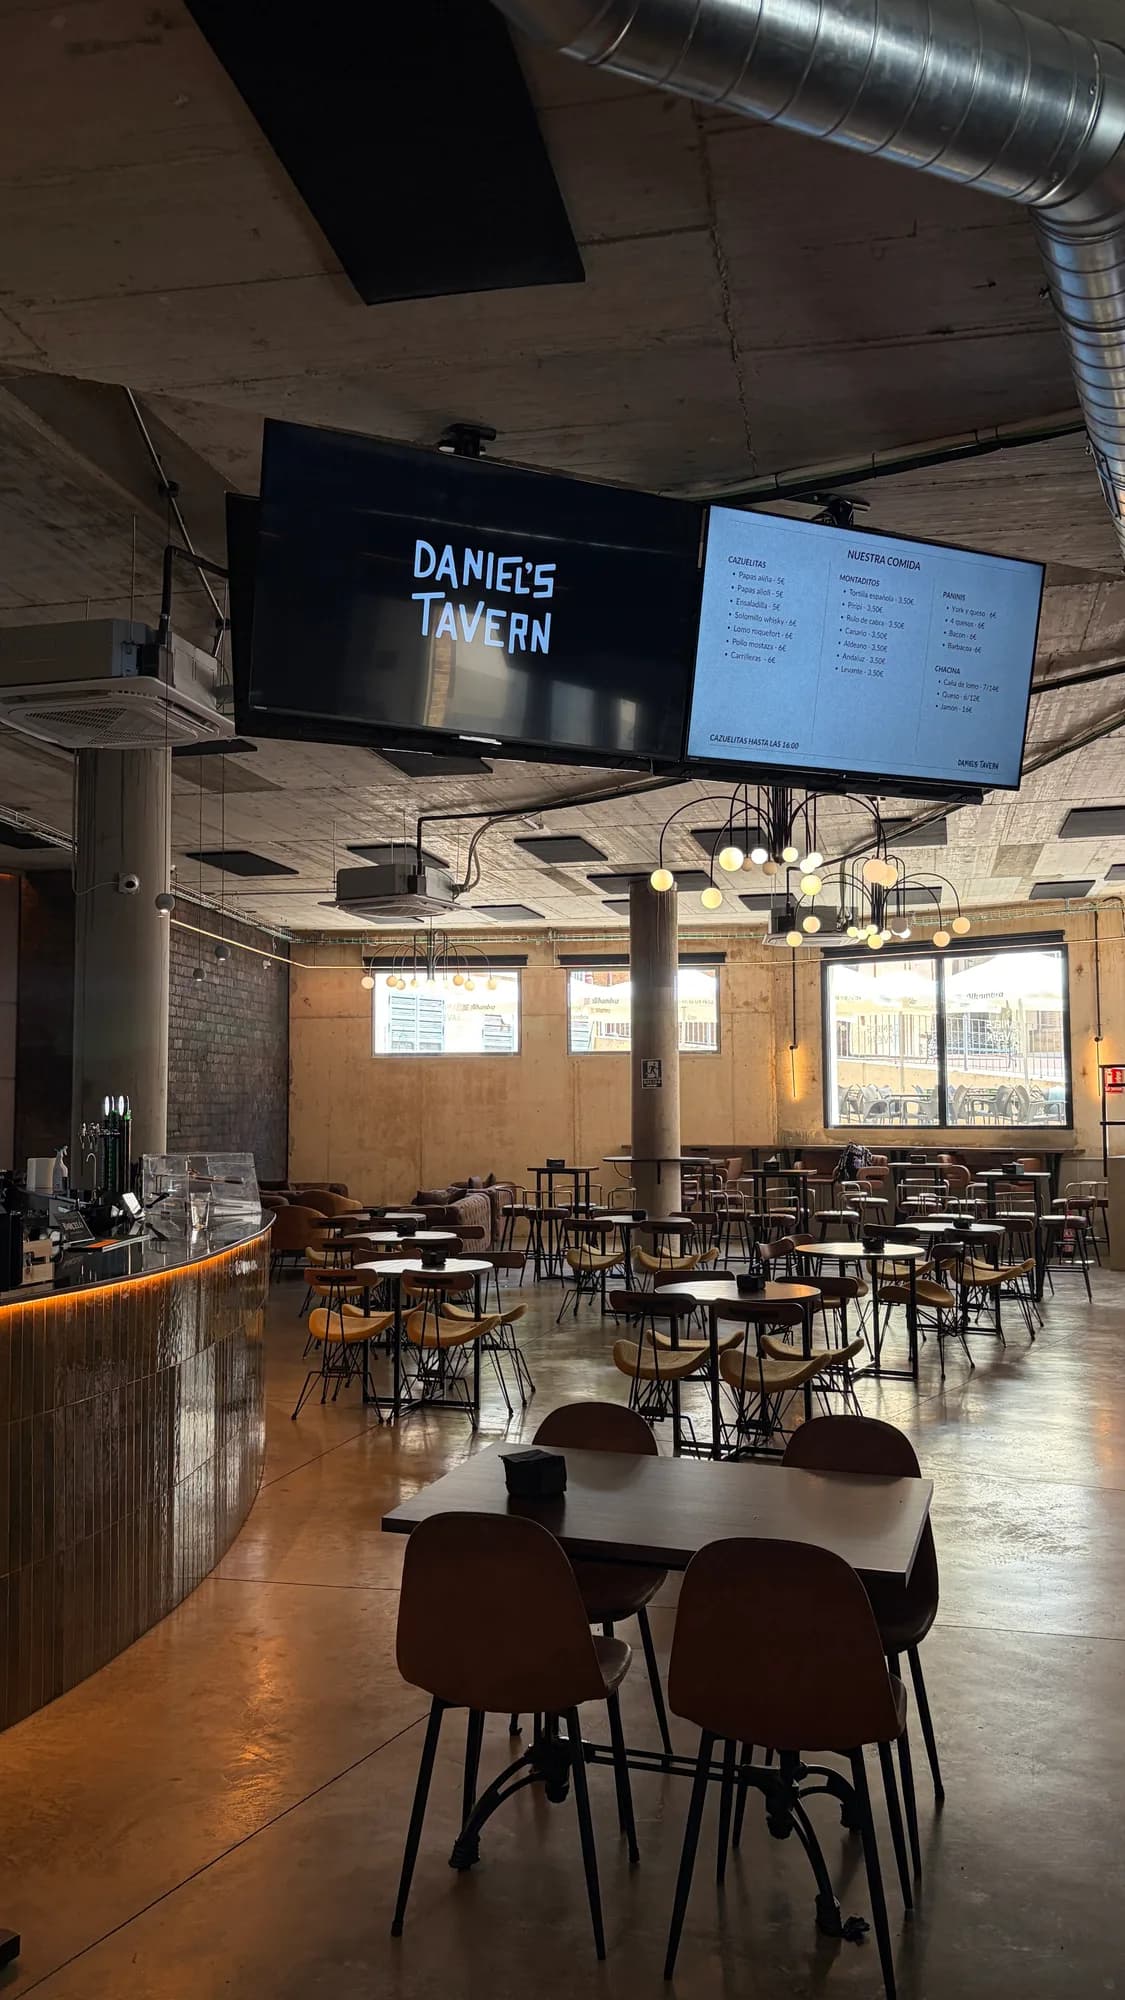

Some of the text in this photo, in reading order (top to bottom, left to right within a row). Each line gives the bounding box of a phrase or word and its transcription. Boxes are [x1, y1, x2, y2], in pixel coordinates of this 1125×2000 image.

[728, 555, 767, 569] CAZUELITAS
[847, 549, 921, 571] NUESTRA COMIDA
[413, 539, 556, 599] DANIEL'S
[738, 571, 756, 581] Papas
[776, 577, 785, 586] 5€
[839, 574, 881, 587] MONTADITOS
[737, 584, 755, 595] Papas
[776, 590, 784, 599] 5€
[850, 588, 868, 598] Tortilla
[869, 593, 894, 602] española
[898, 597, 915, 606] 3.50€
[942, 592, 966, 601] PANINIS
[735, 597, 768, 609] Ensaladilla
[772, 603, 781, 611] 5€
[867, 604, 883, 614] 3.50€
[951, 605, 964, 613] York
[411, 592, 552, 655] TAVERN
[734, 611, 762, 622] Solomillo
[763, 617, 784, 626] whisky
[788, 619, 797, 627] 6€
[846, 614, 859, 623] Rulo
[888, 620, 905, 630] 3.50€
[733, 625, 751, 634] Lomo
[752, 628, 781, 638] roquefort
[785, 632, 793, 640] 6€
[845, 627, 867, 637] Canario
[871, 630, 888, 640] 3.50€
[948, 630, 966, 638] Bacon
[732, 638, 748, 647] Pollo
[748, 641, 773, 650] mostaza
[778, 644, 786, 652] 6€
[843, 640, 867, 650] Aldeano
[871, 643, 888, 653] 3.50€
[947, 642, 972, 652] Barbacoa
[730, 651, 761, 662] Carrilleras
[767, 656, 776, 664] 6€
[842, 652, 865, 662] Andaluz
[869, 656, 886, 665] 3.50€
[841, 665, 863, 675] Levante
[867, 669, 884, 678] 3.50€
[934, 665, 961, 675] CHACINA
[943, 679, 957, 687] Caña
[965, 682, 979, 690] lomo
[942, 691, 960, 700] Queso
[709, 733, 748, 745] CAZUELITAS
[748, 737, 769, 747] HASTA
[769, 740, 782, 748] LAS
